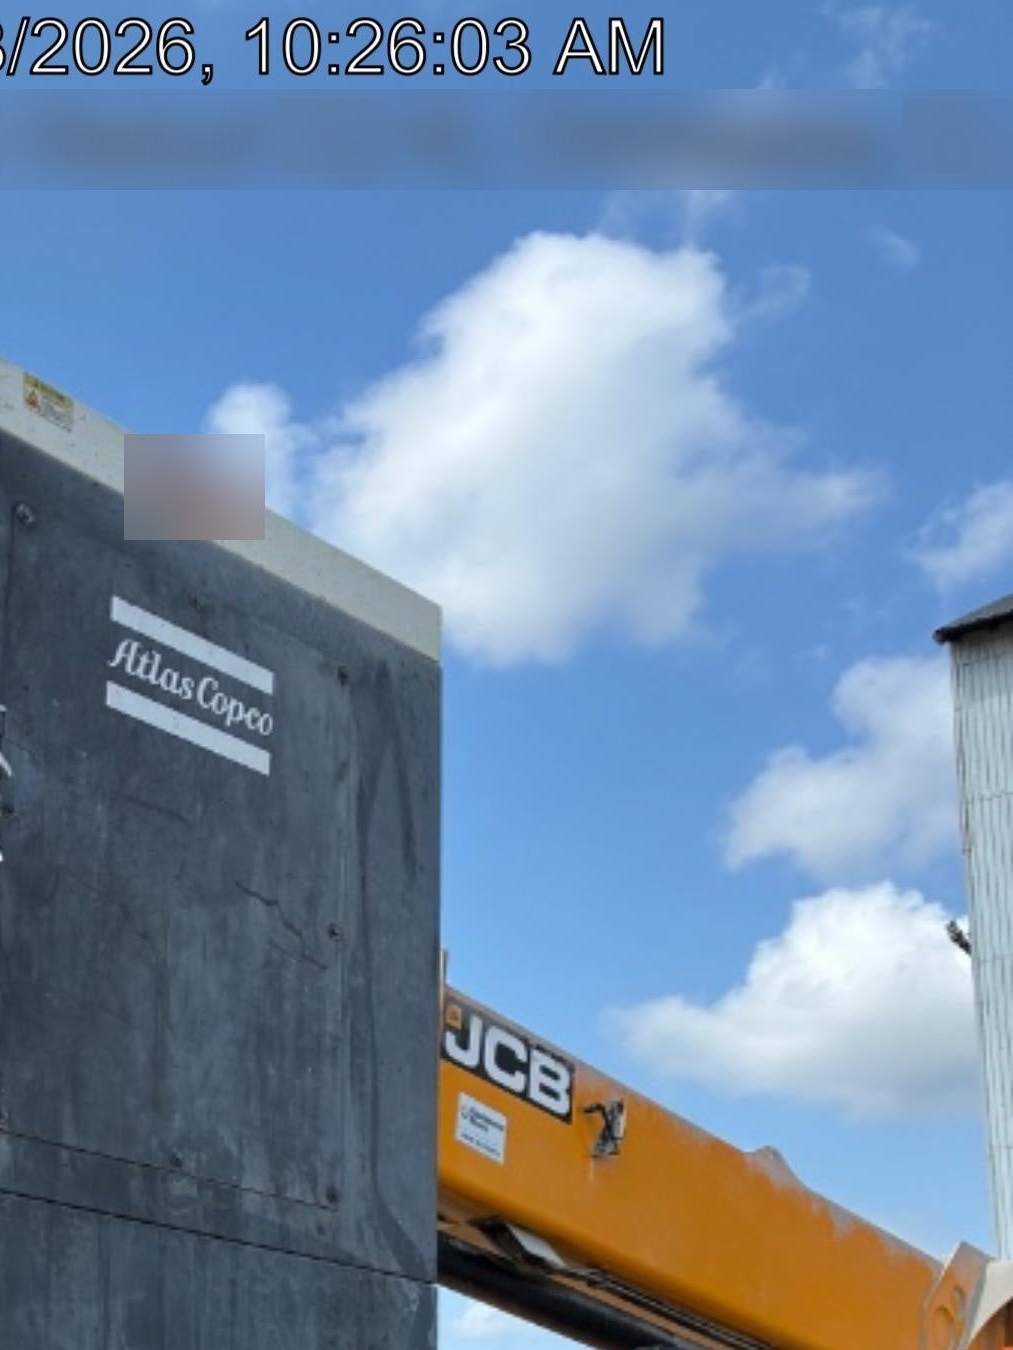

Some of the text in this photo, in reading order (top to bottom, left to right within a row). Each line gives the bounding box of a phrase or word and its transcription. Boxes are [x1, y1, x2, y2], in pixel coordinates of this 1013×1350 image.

[107, 638, 274, 736] Atlas Copco
[444, 1014, 572, 1118] JCB
